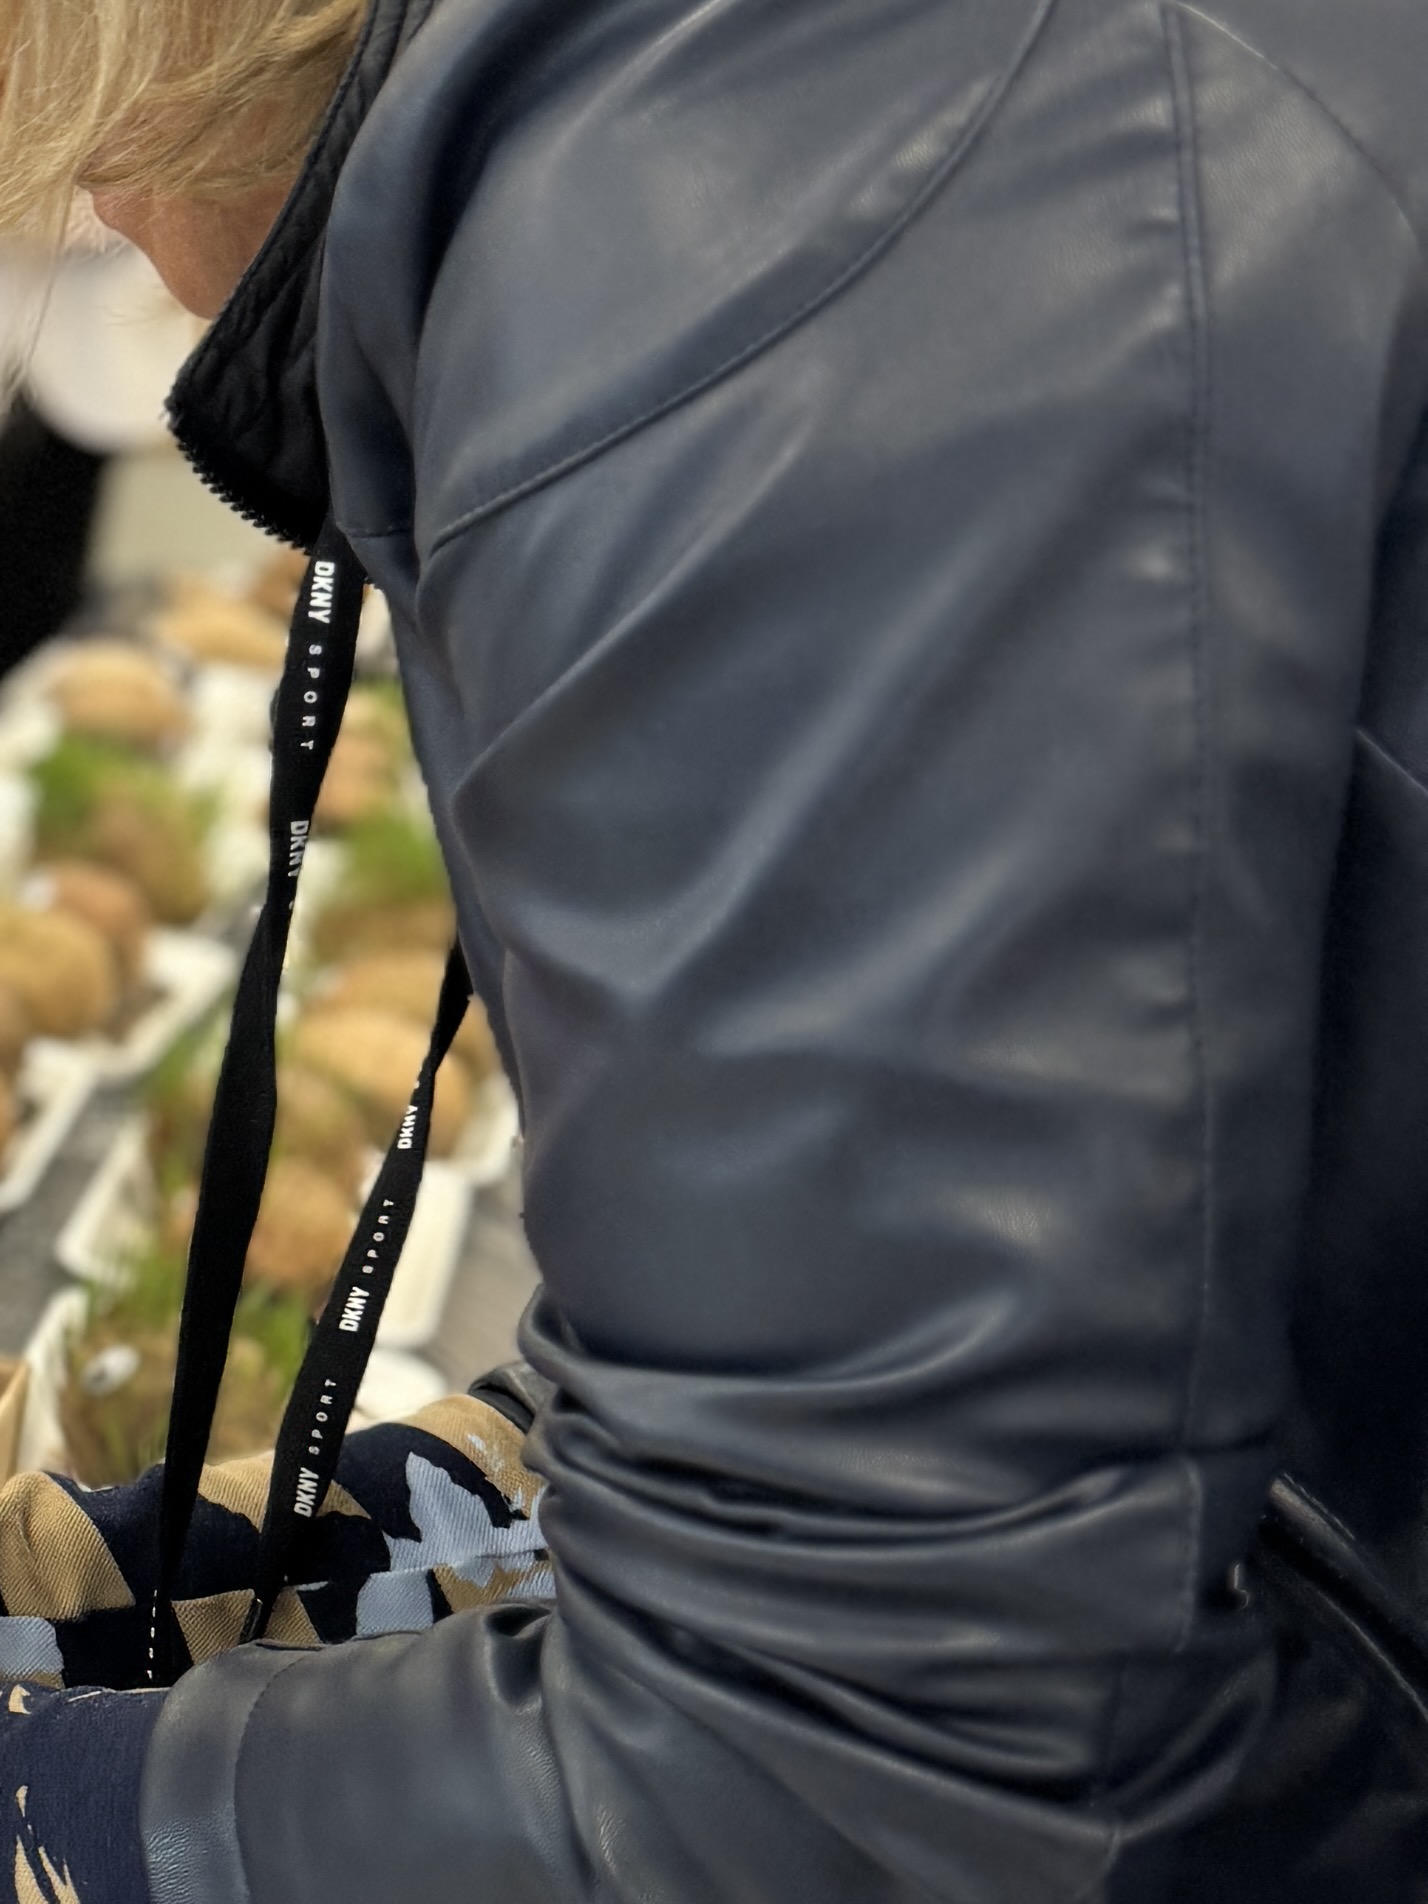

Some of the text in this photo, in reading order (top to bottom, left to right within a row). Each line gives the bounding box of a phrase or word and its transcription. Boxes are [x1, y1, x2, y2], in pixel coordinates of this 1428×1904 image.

[300, 560, 336, 751] DKNY SPORT
[287, 819, 310, 878] DKNY
[397, 1103, 419, 1150] DKNY
[338, 1198, 395, 1332] DKNY SPORT
[293, 1378, 337, 1518] DKNY SPORT
